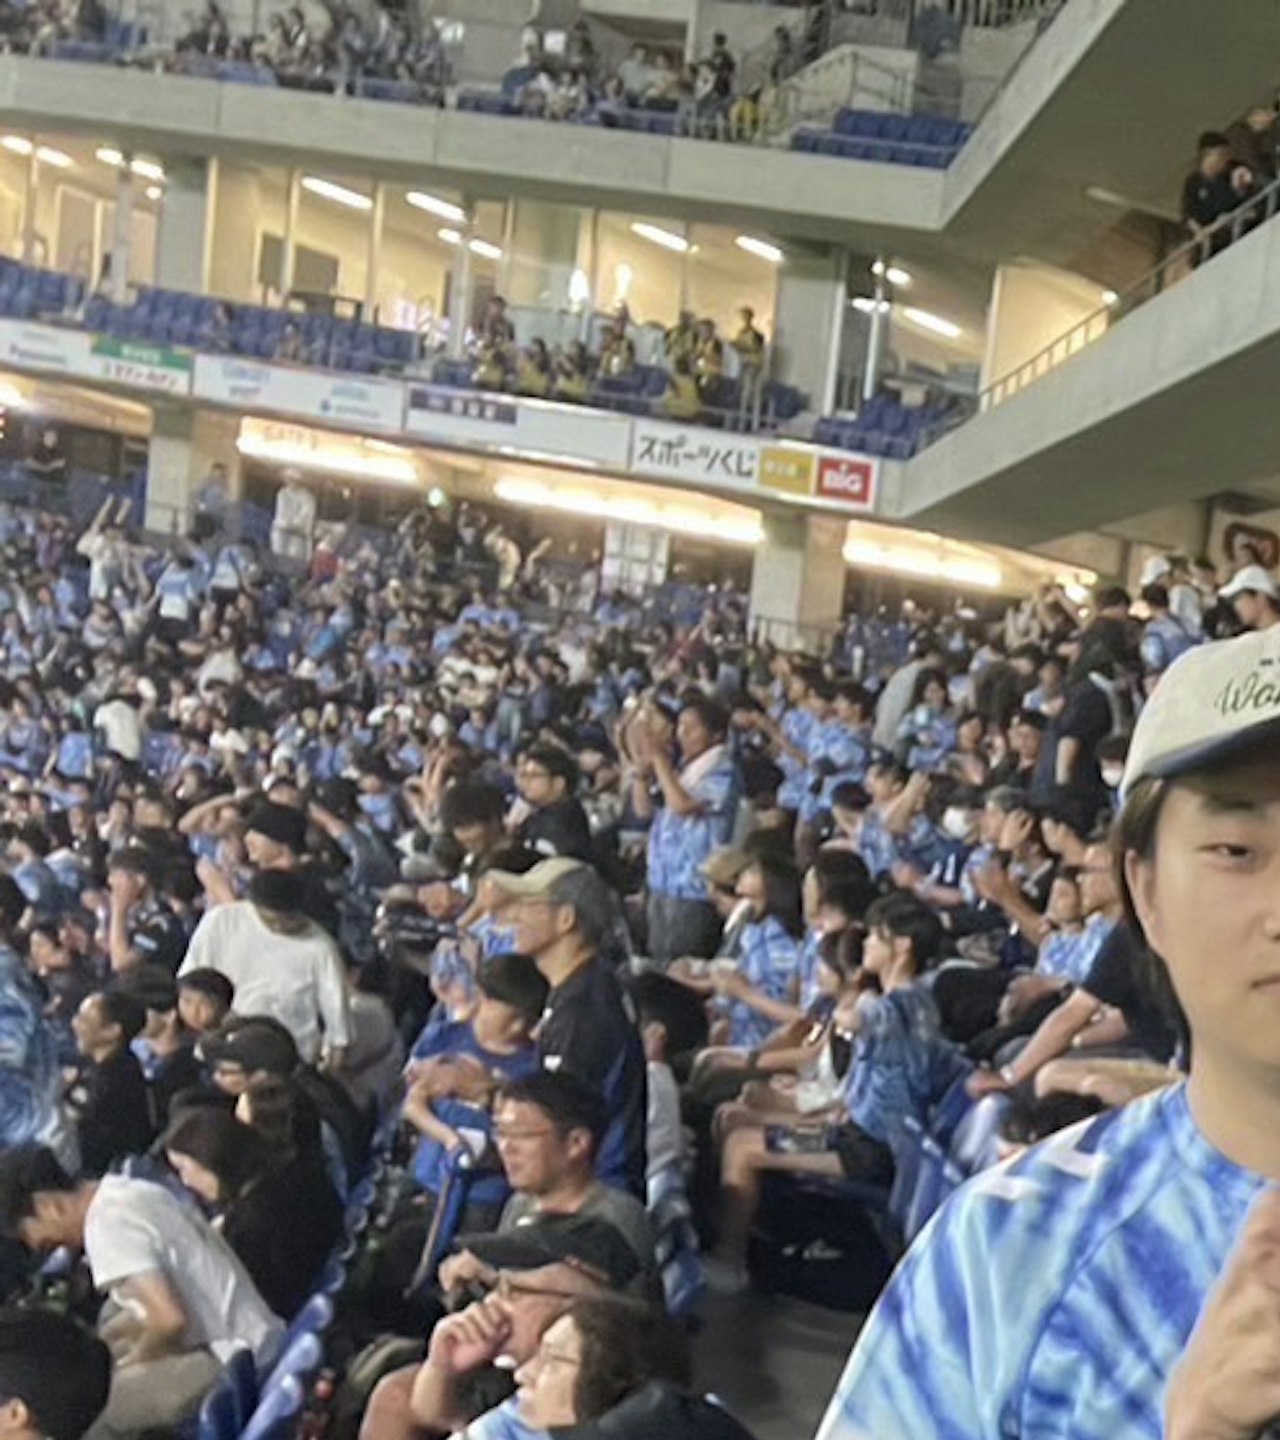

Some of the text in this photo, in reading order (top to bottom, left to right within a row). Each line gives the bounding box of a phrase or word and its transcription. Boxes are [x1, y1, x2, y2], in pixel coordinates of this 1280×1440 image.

[638, 433, 757, 478] スポーツくじ
